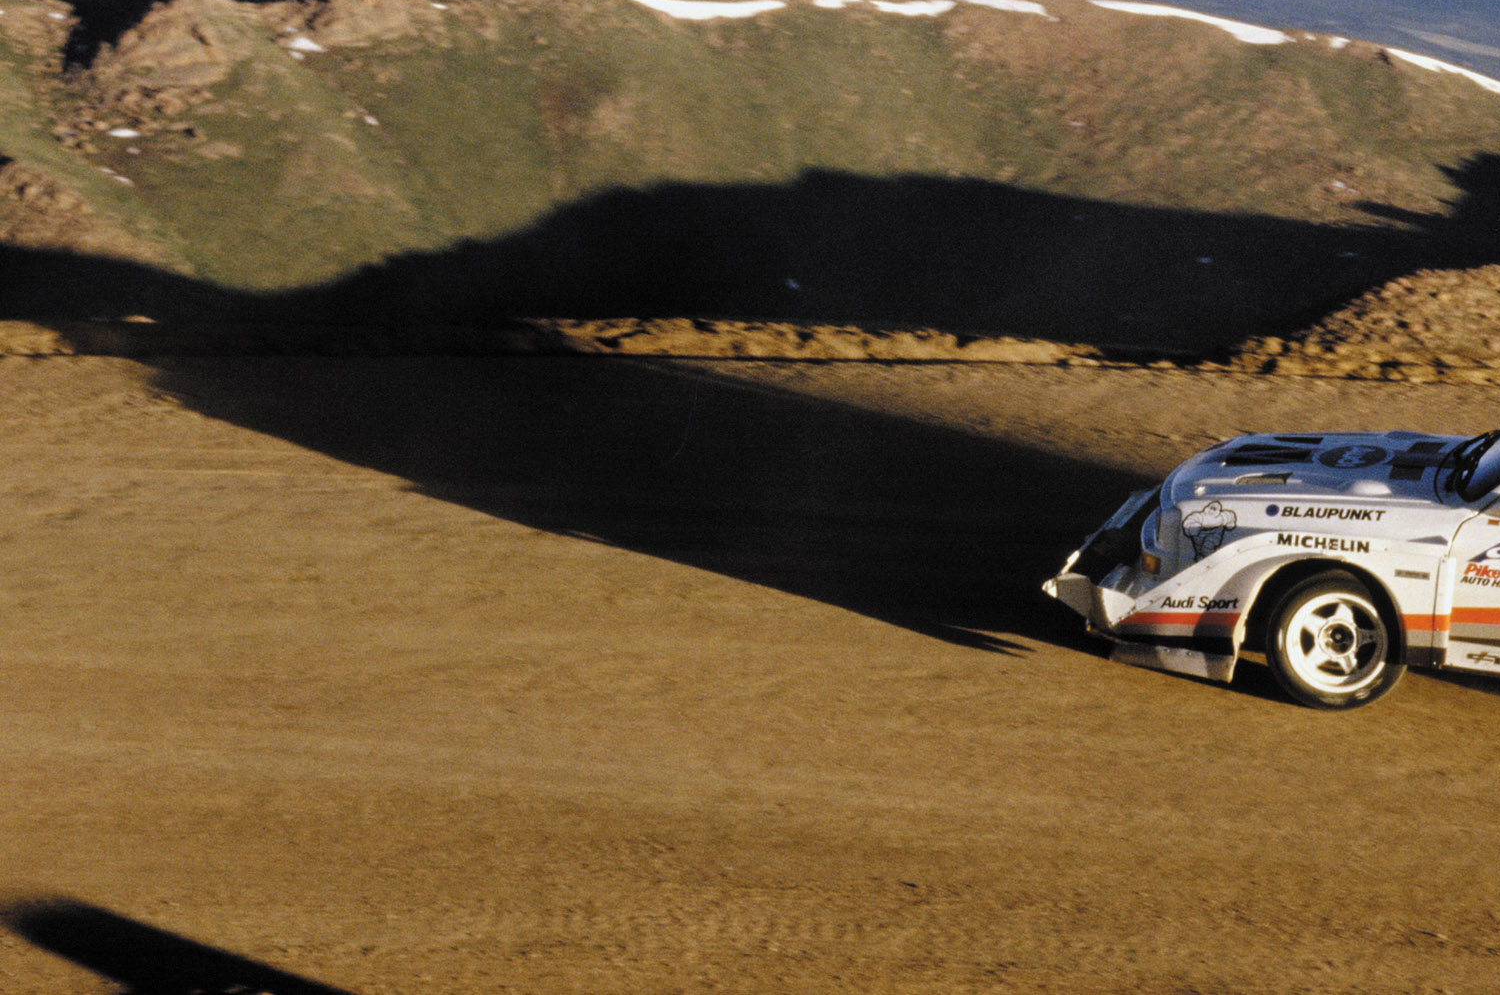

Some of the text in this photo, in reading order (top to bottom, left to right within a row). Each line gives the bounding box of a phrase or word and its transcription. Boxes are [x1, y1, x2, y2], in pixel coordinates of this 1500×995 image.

[1281, 506, 1386, 522] BLAUPUNKT
[1277, 533, 1370, 553] MICHELIN
[1460, 575, 1490, 586] AUTO
[1161, 596, 1239, 611] Audi Sport
